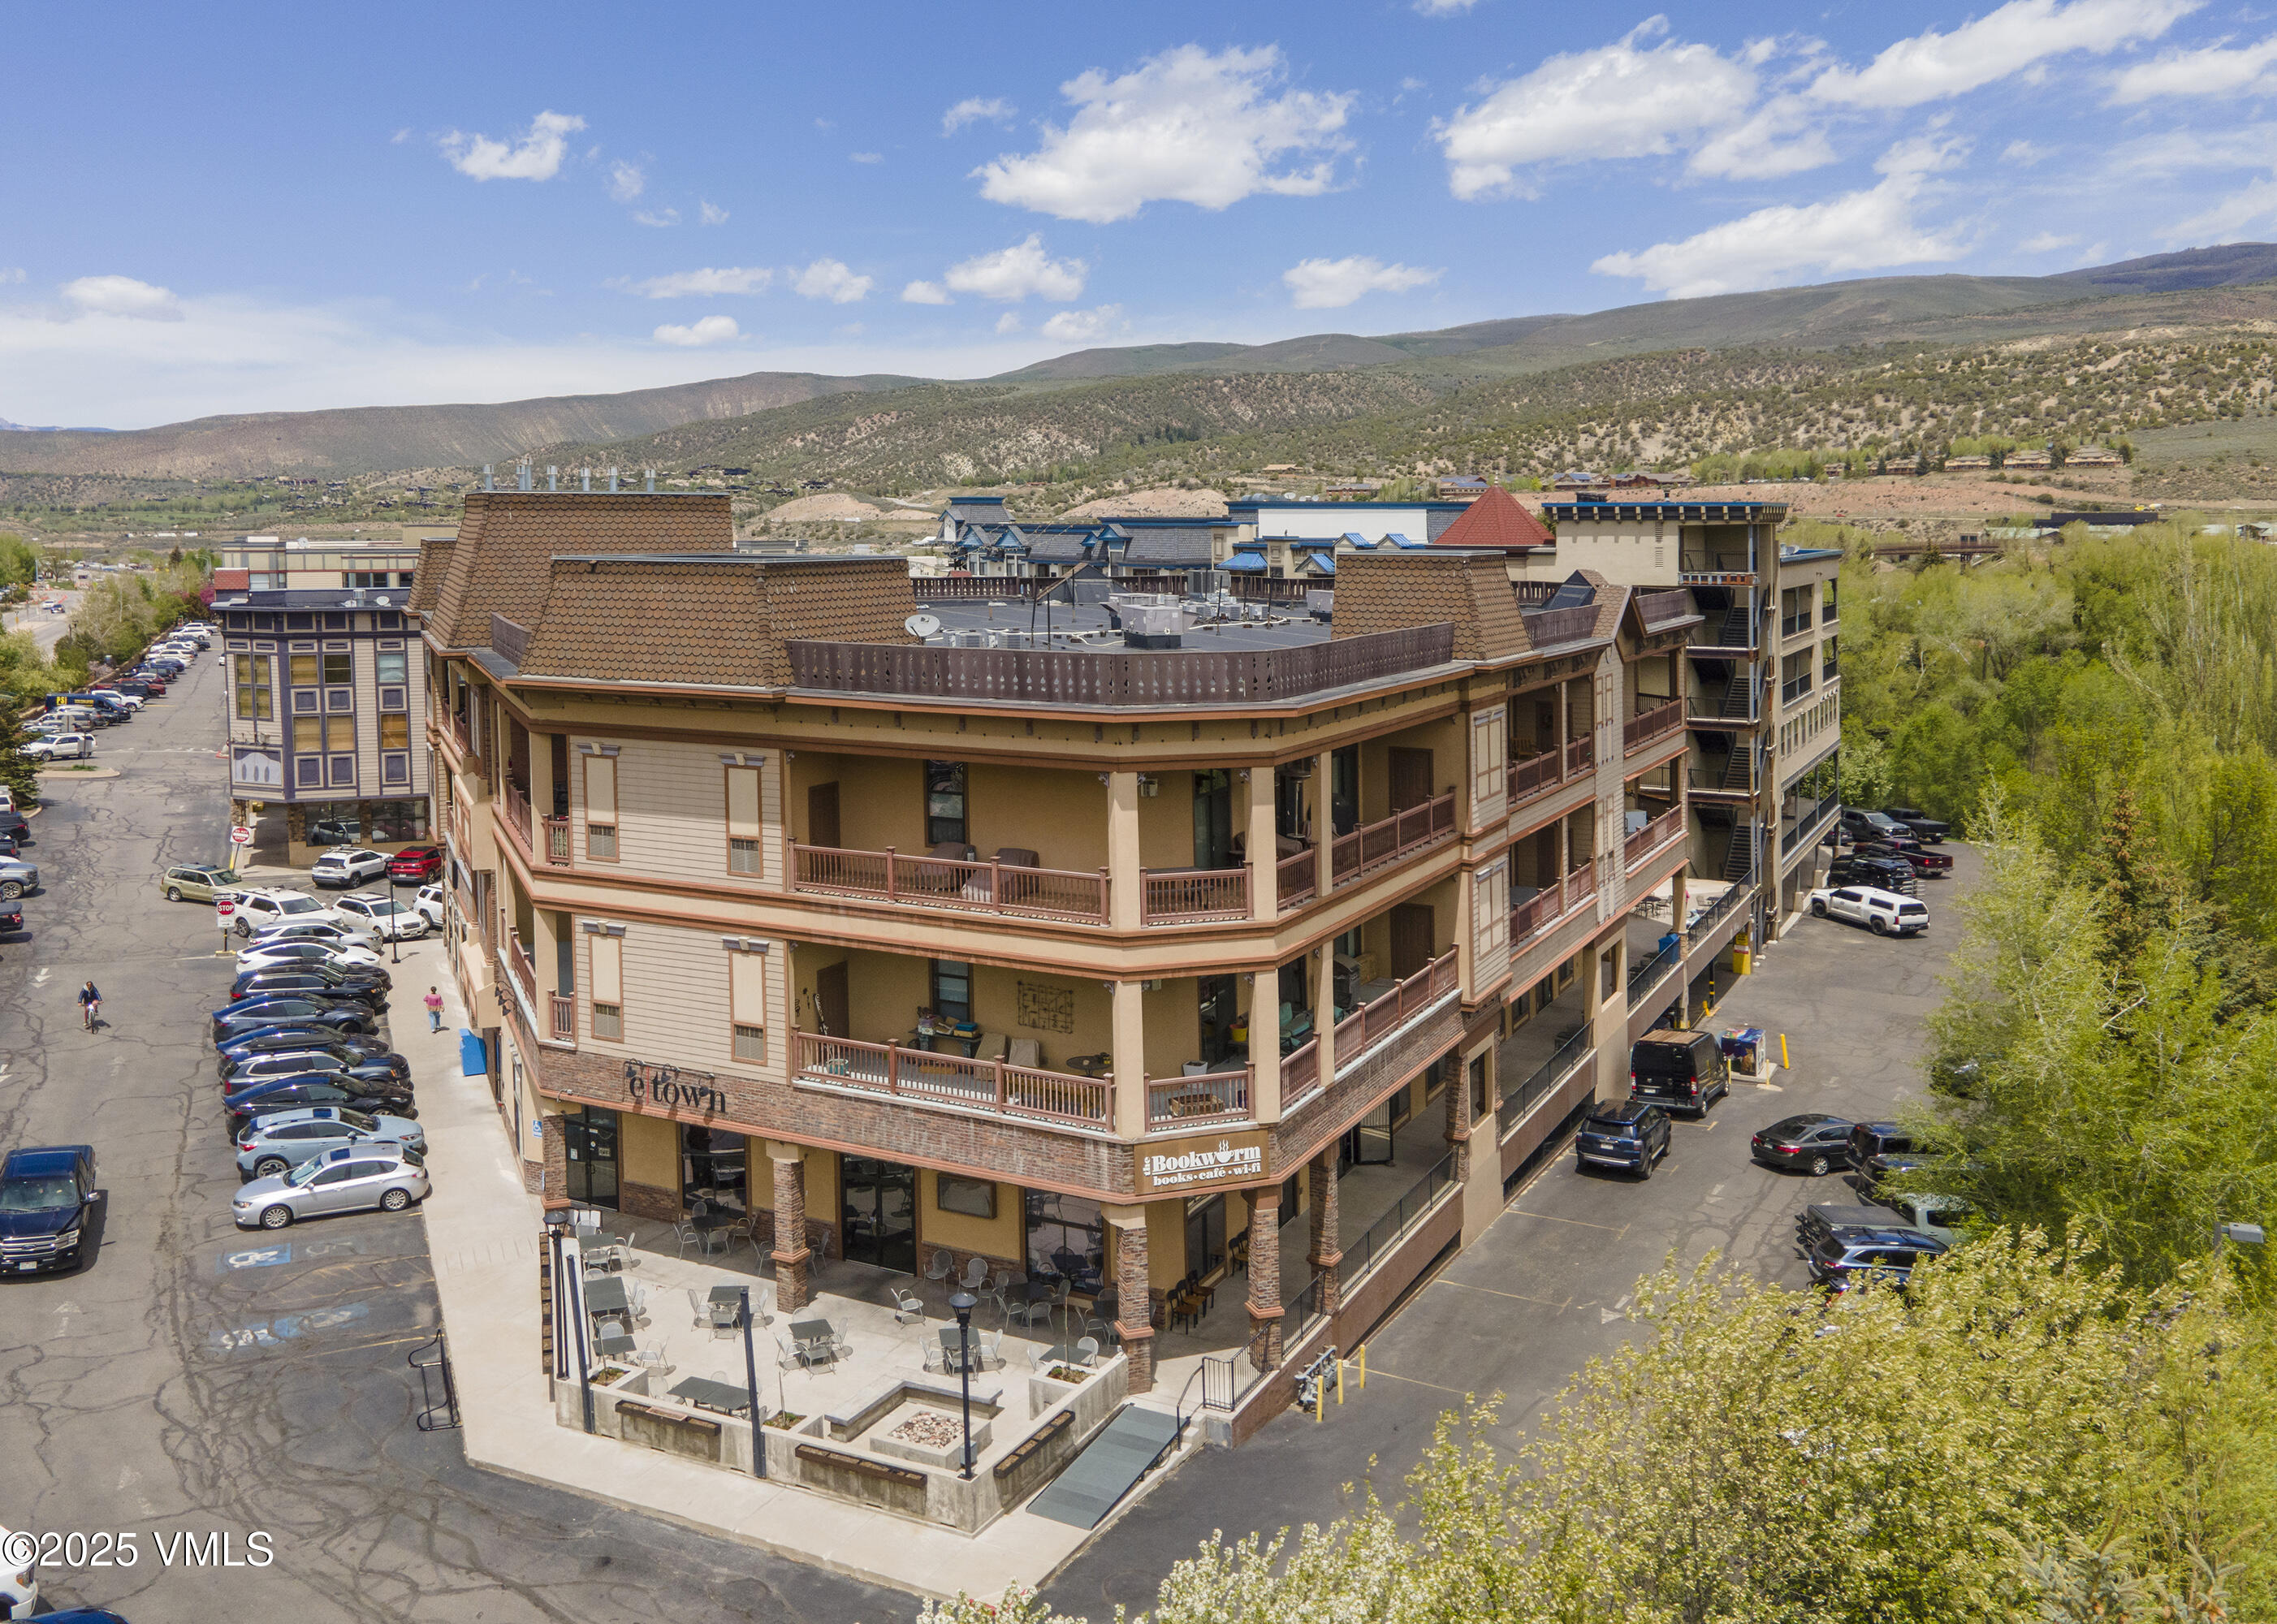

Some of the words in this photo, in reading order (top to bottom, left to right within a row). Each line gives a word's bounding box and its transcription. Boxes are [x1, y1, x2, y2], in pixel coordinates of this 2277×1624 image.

[651, 1071, 726, 1113] town
[1143, 1156, 1151, 1176] the
[1151, 1145, 1262, 1173] Bookworm
[1153, 1173, 1194, 1186] books
[1199, 1167, 1226, 1181] café
[1233, 1162, 1261, 1176] wi-fi
